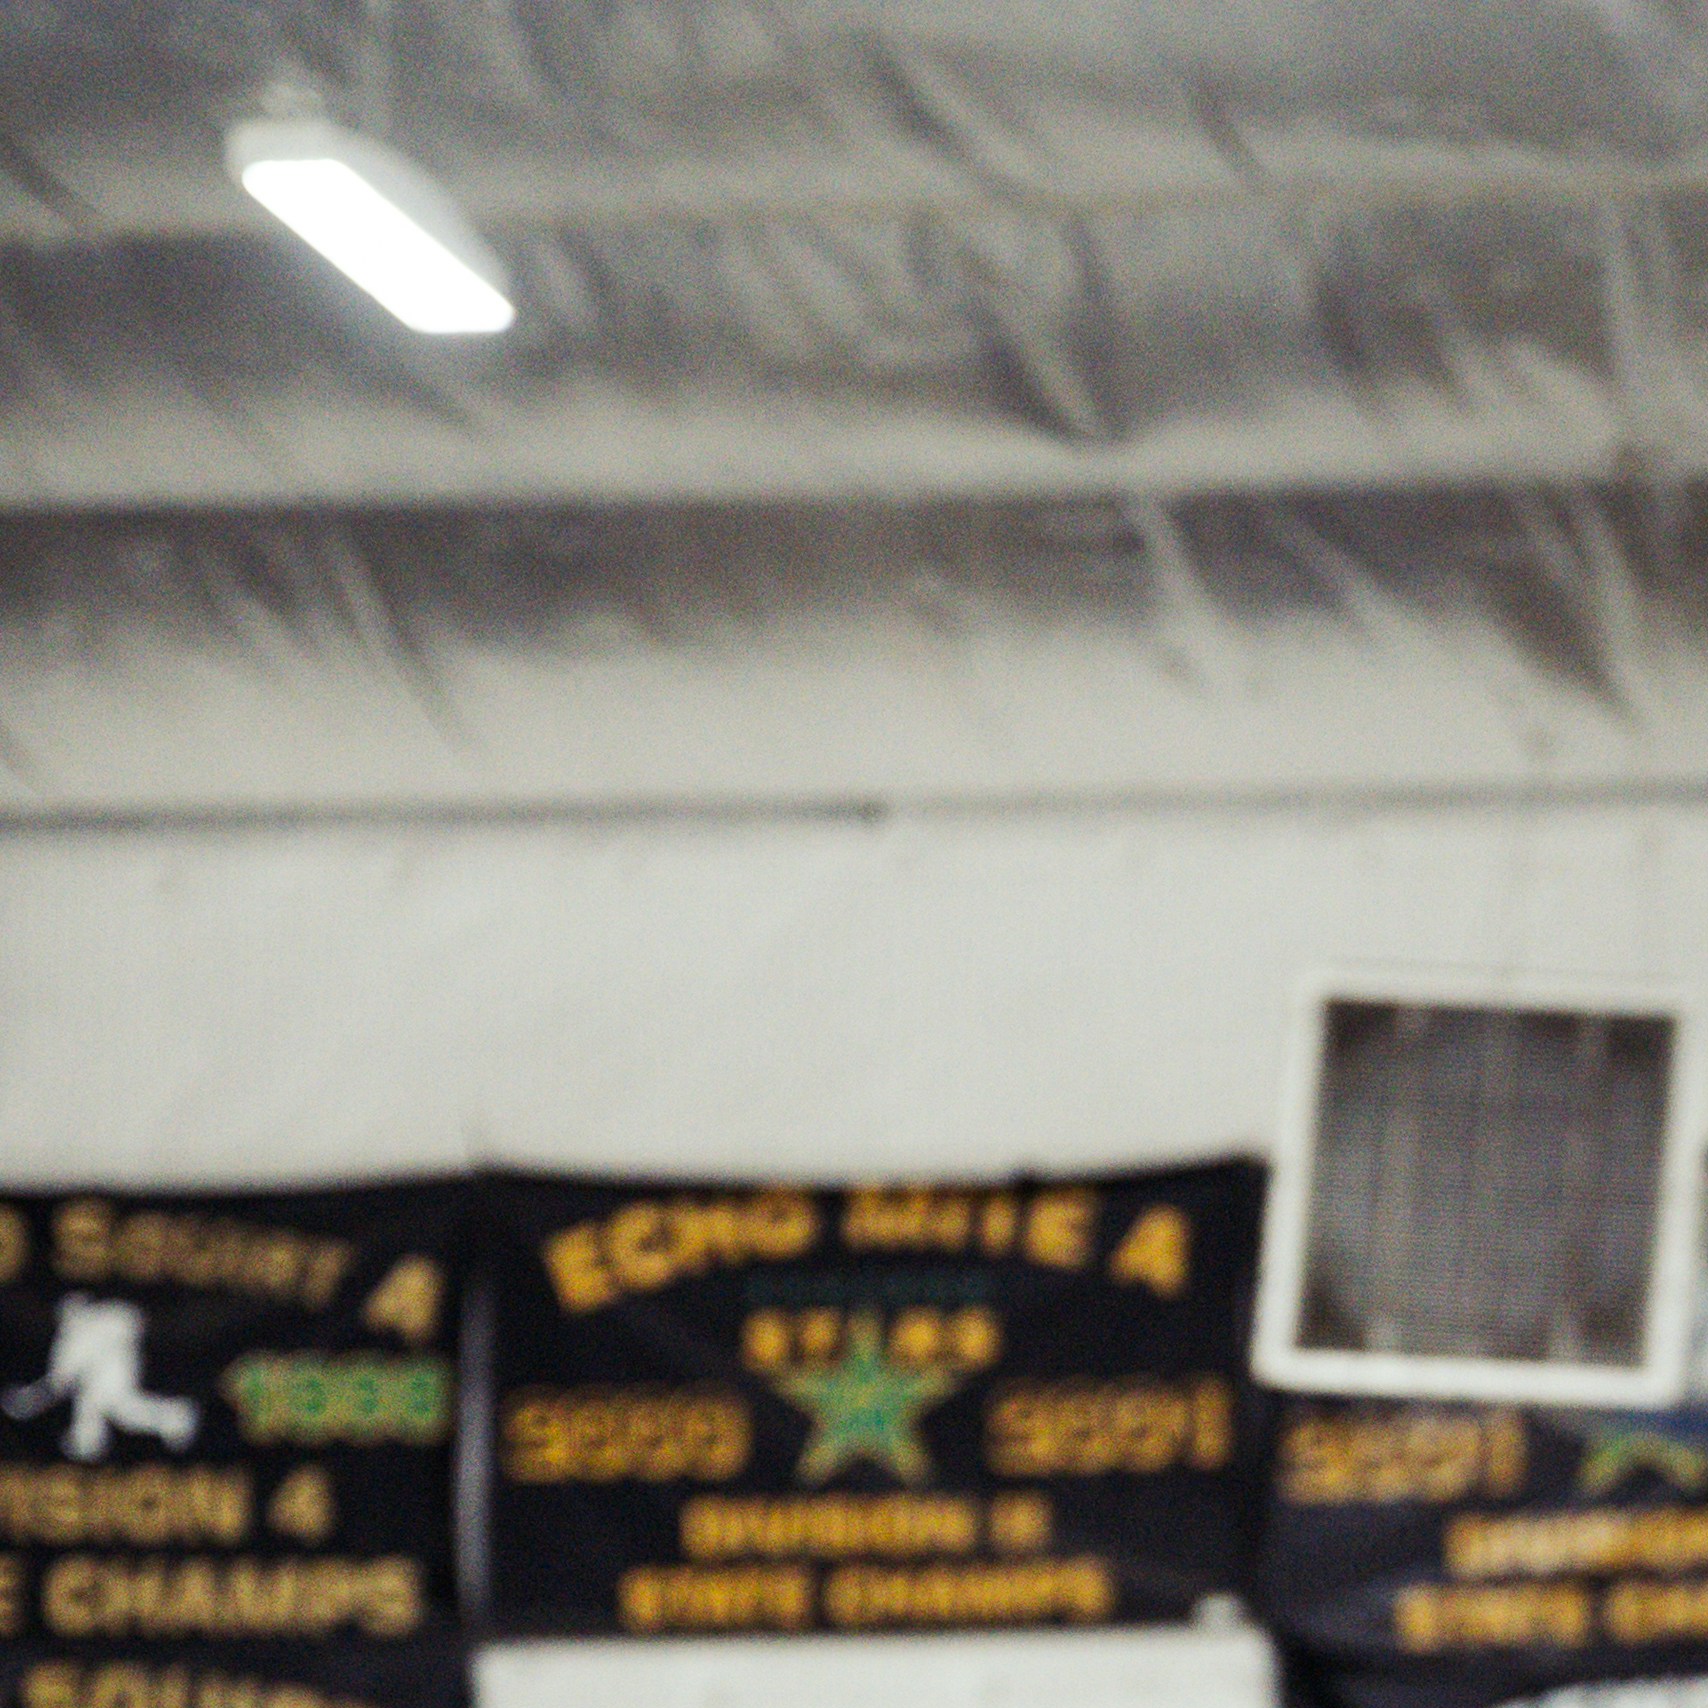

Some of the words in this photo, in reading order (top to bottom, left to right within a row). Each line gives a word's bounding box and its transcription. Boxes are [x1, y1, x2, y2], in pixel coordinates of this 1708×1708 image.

[1115, 1209, 1186, 1293] A
[365, 1258, 439, 1337] A
[0, 1468, 248, 1539] ISION
[47, 1559, 420, 1632] CHAMPS
